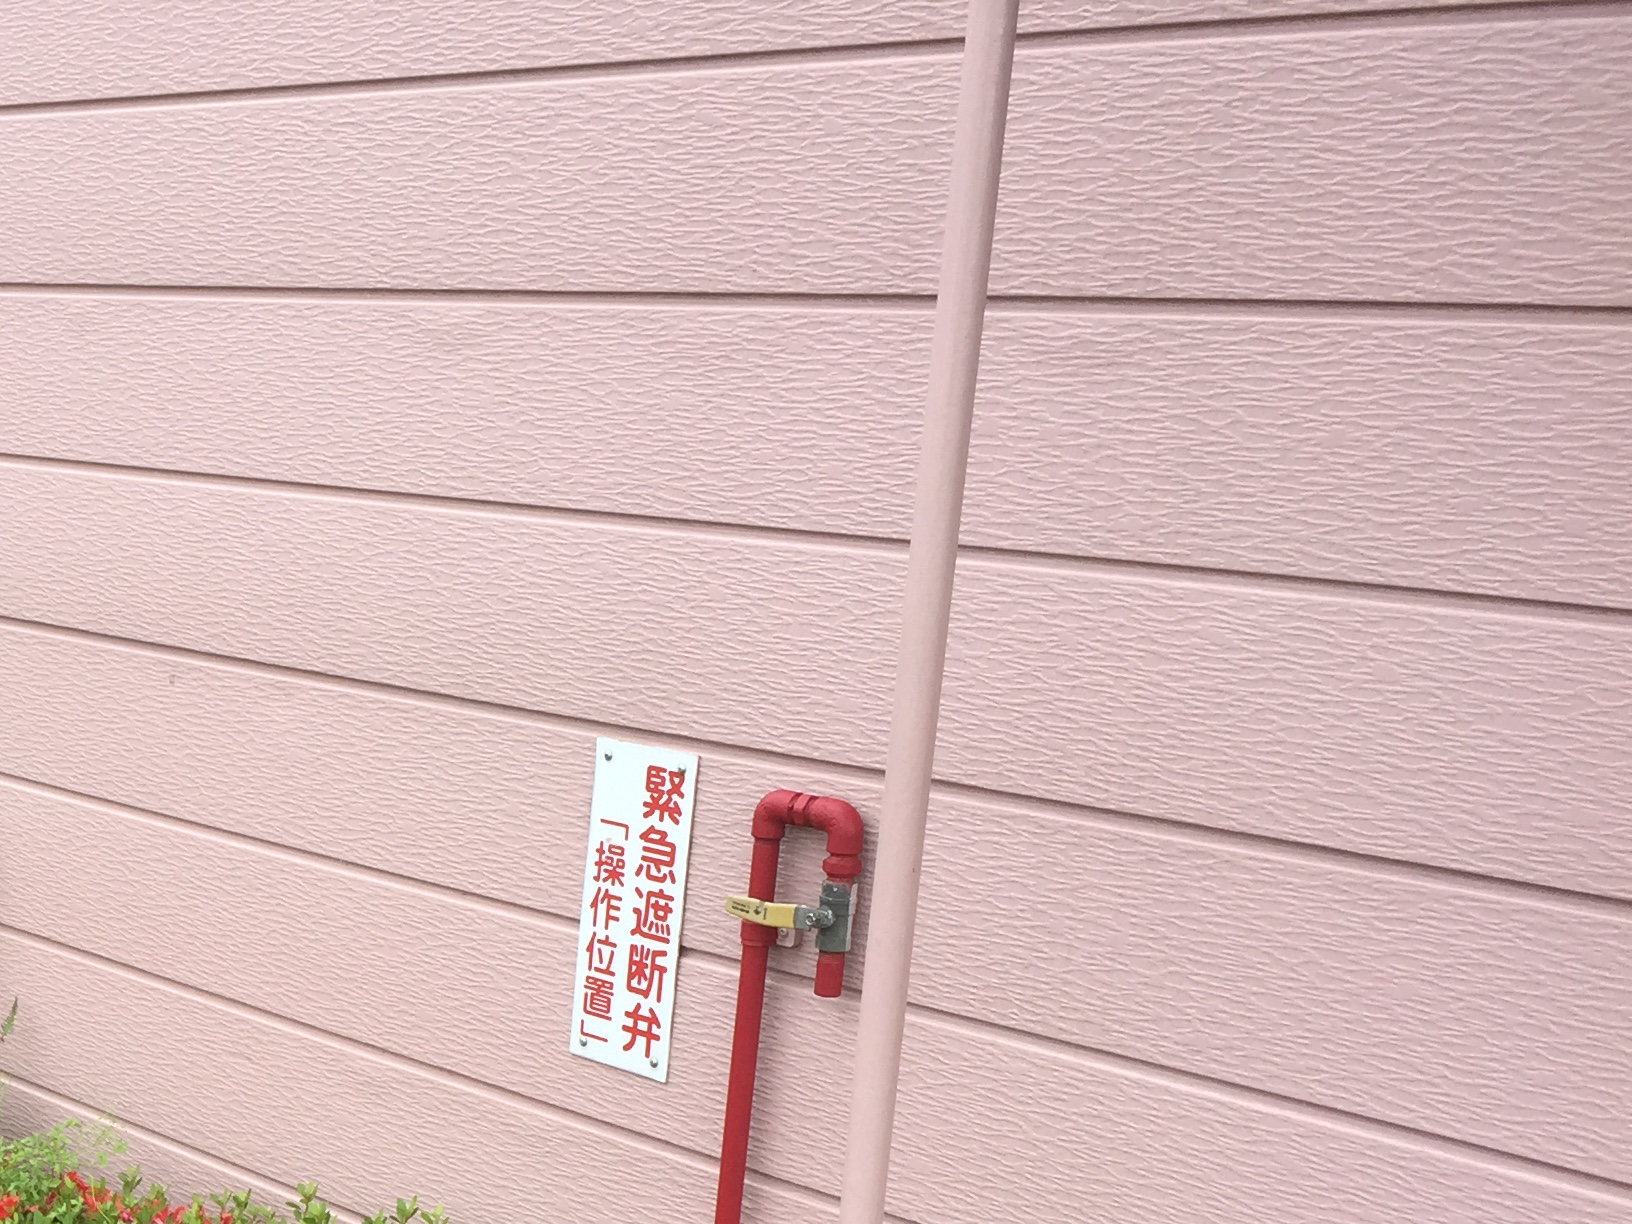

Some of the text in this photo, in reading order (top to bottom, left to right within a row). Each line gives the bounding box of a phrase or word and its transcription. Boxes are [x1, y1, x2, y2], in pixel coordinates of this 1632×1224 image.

[580, 818, 630, 1043] 「操作位置」
[621, 765, 686, 1058] 緊急遮断弁
